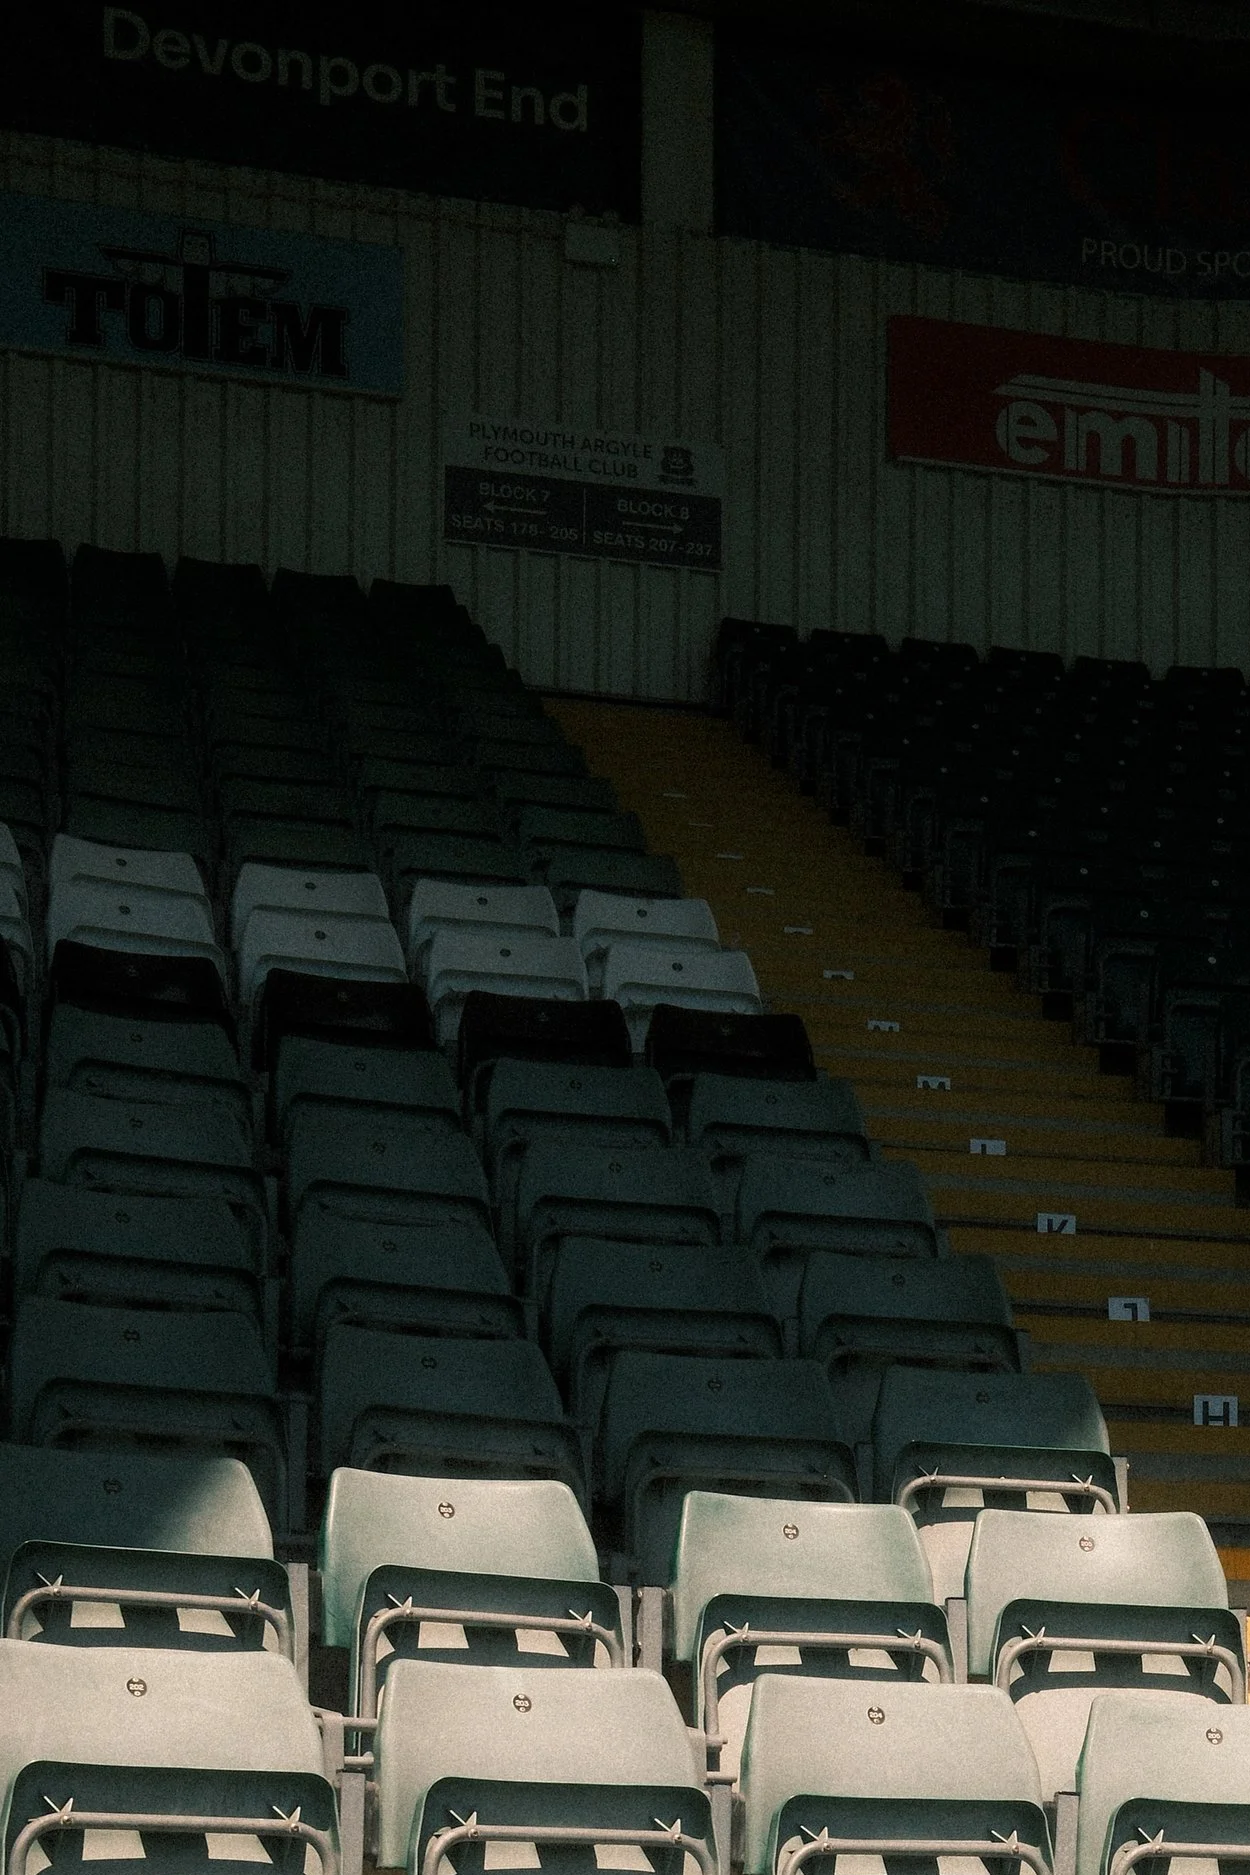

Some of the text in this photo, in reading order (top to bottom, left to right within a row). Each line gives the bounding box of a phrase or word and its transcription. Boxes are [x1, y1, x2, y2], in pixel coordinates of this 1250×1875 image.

[102, 6, 589, 132] Devonport End
[1081, 237, 1188, 276] PROUD
[468, 421, 653, 461] PLYMOUTH ARGYLE
[483, 445, 583, 473] FOOTBALL
[588, 458, 639, 479] CLUB
[478, 482, 551, 502] BLOCK 7
[617, 499, 676, 519] BLOCK
[451, 513, 505, 533] SEATS
[549, 525, 579, 541] 205
[593, 530, 646, 550] SEATS
[1202, 1400, 1230, 1426] H
